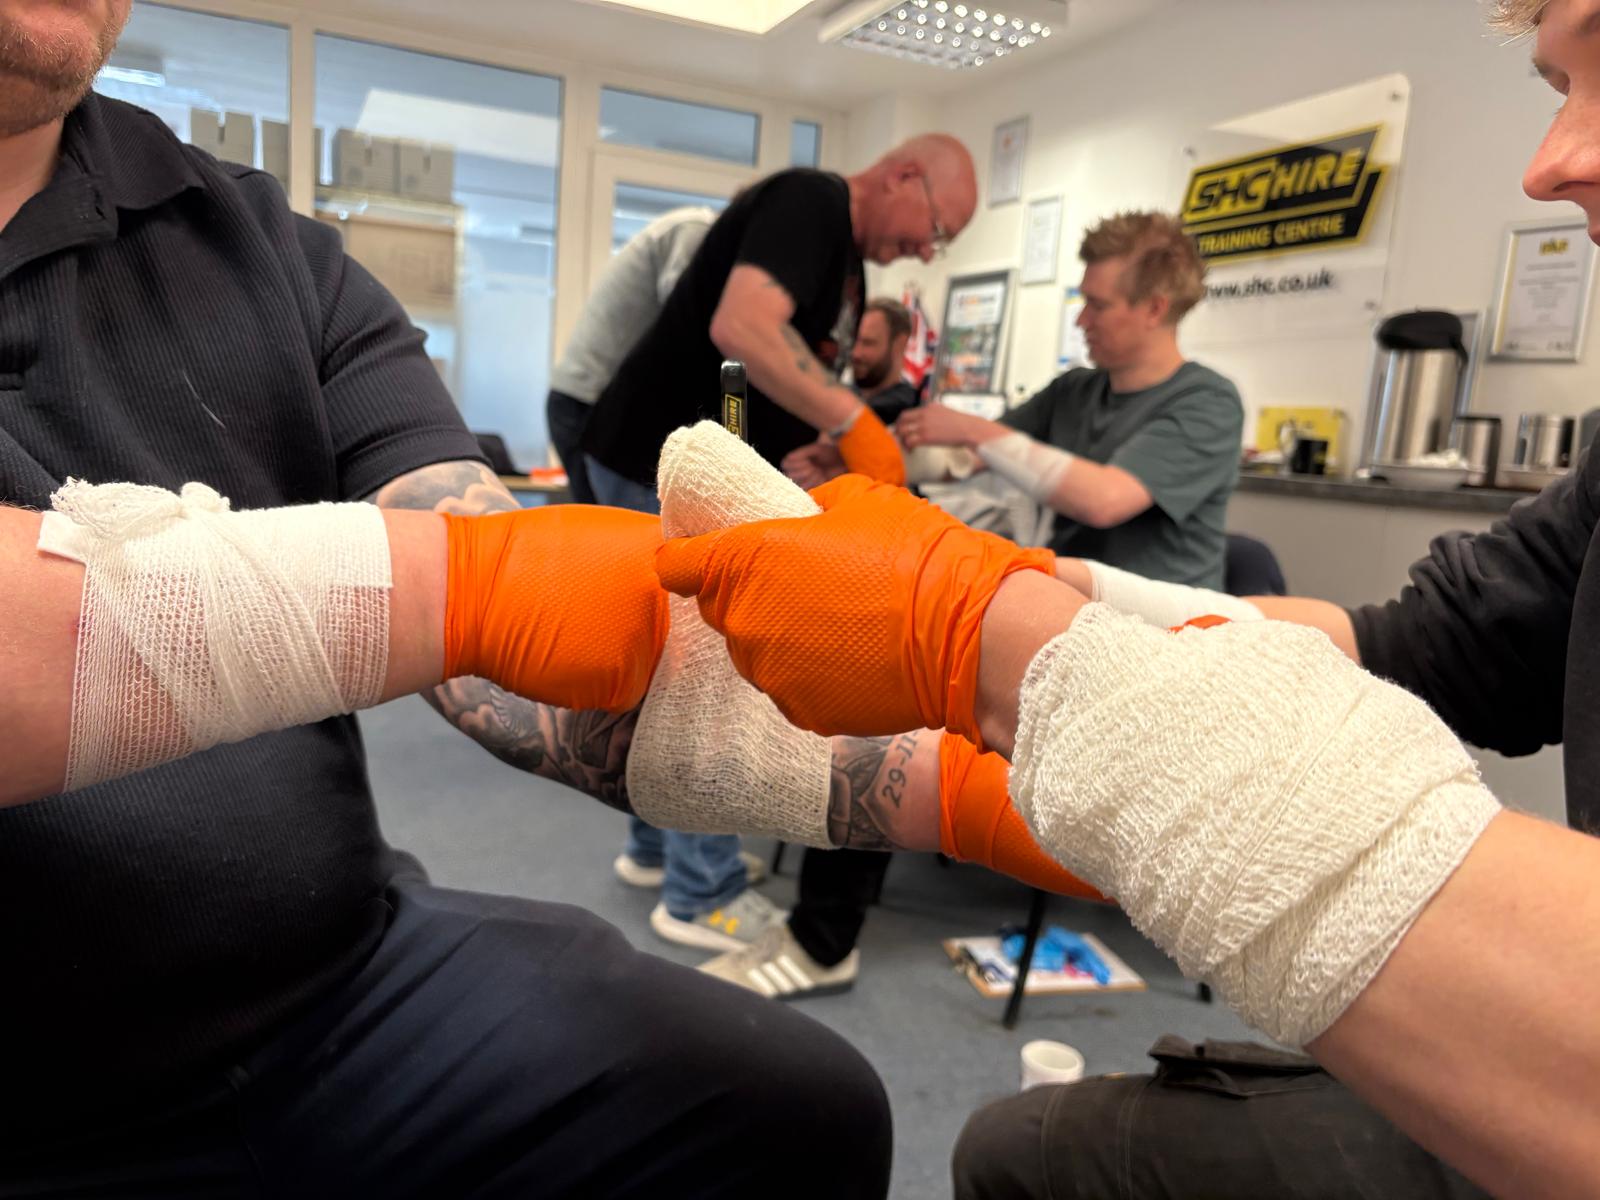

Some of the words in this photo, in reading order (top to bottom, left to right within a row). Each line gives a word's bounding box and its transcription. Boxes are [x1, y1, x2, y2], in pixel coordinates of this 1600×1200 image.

[1270, 150, 1362, 200] HIRE
[1199, 225, 1272, 254] TRAINING
[1274, 213, 1344, 245] CENTRE
